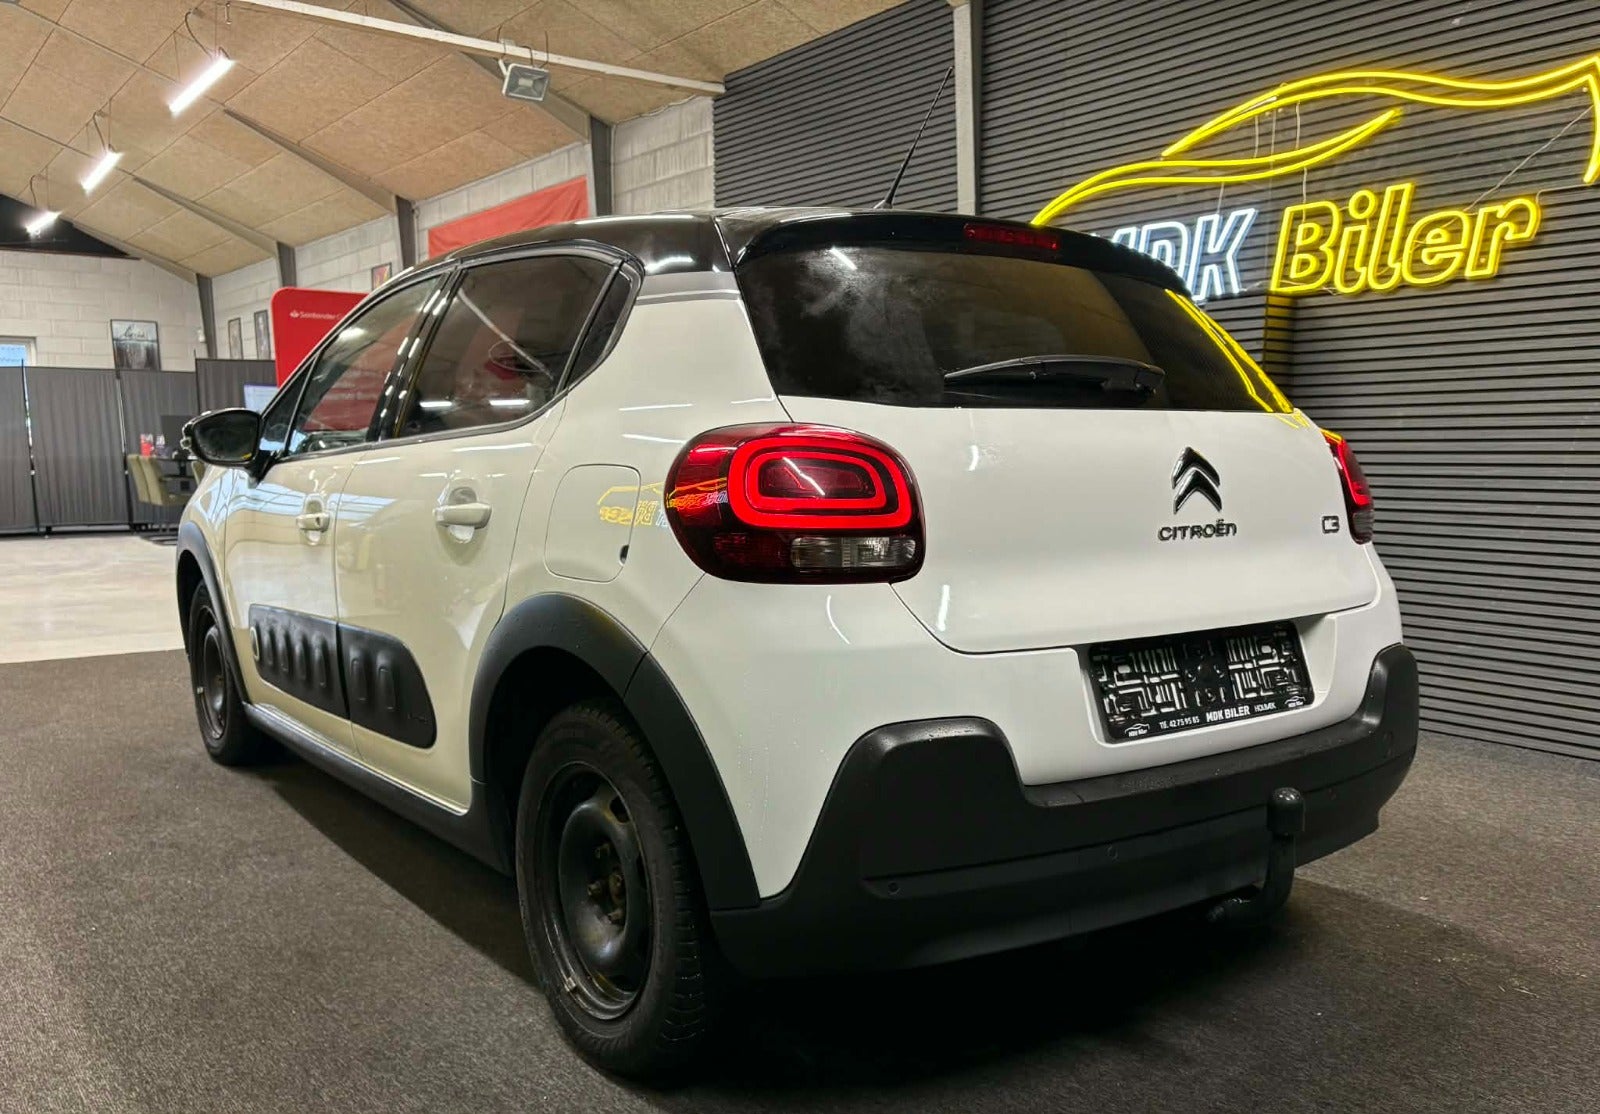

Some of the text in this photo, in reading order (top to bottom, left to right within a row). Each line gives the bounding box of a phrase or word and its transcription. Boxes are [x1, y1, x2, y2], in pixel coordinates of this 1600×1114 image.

[1091, 181, 1542, 302] DK Biler
[1205, 705, 1251, 723] MDK BILER
